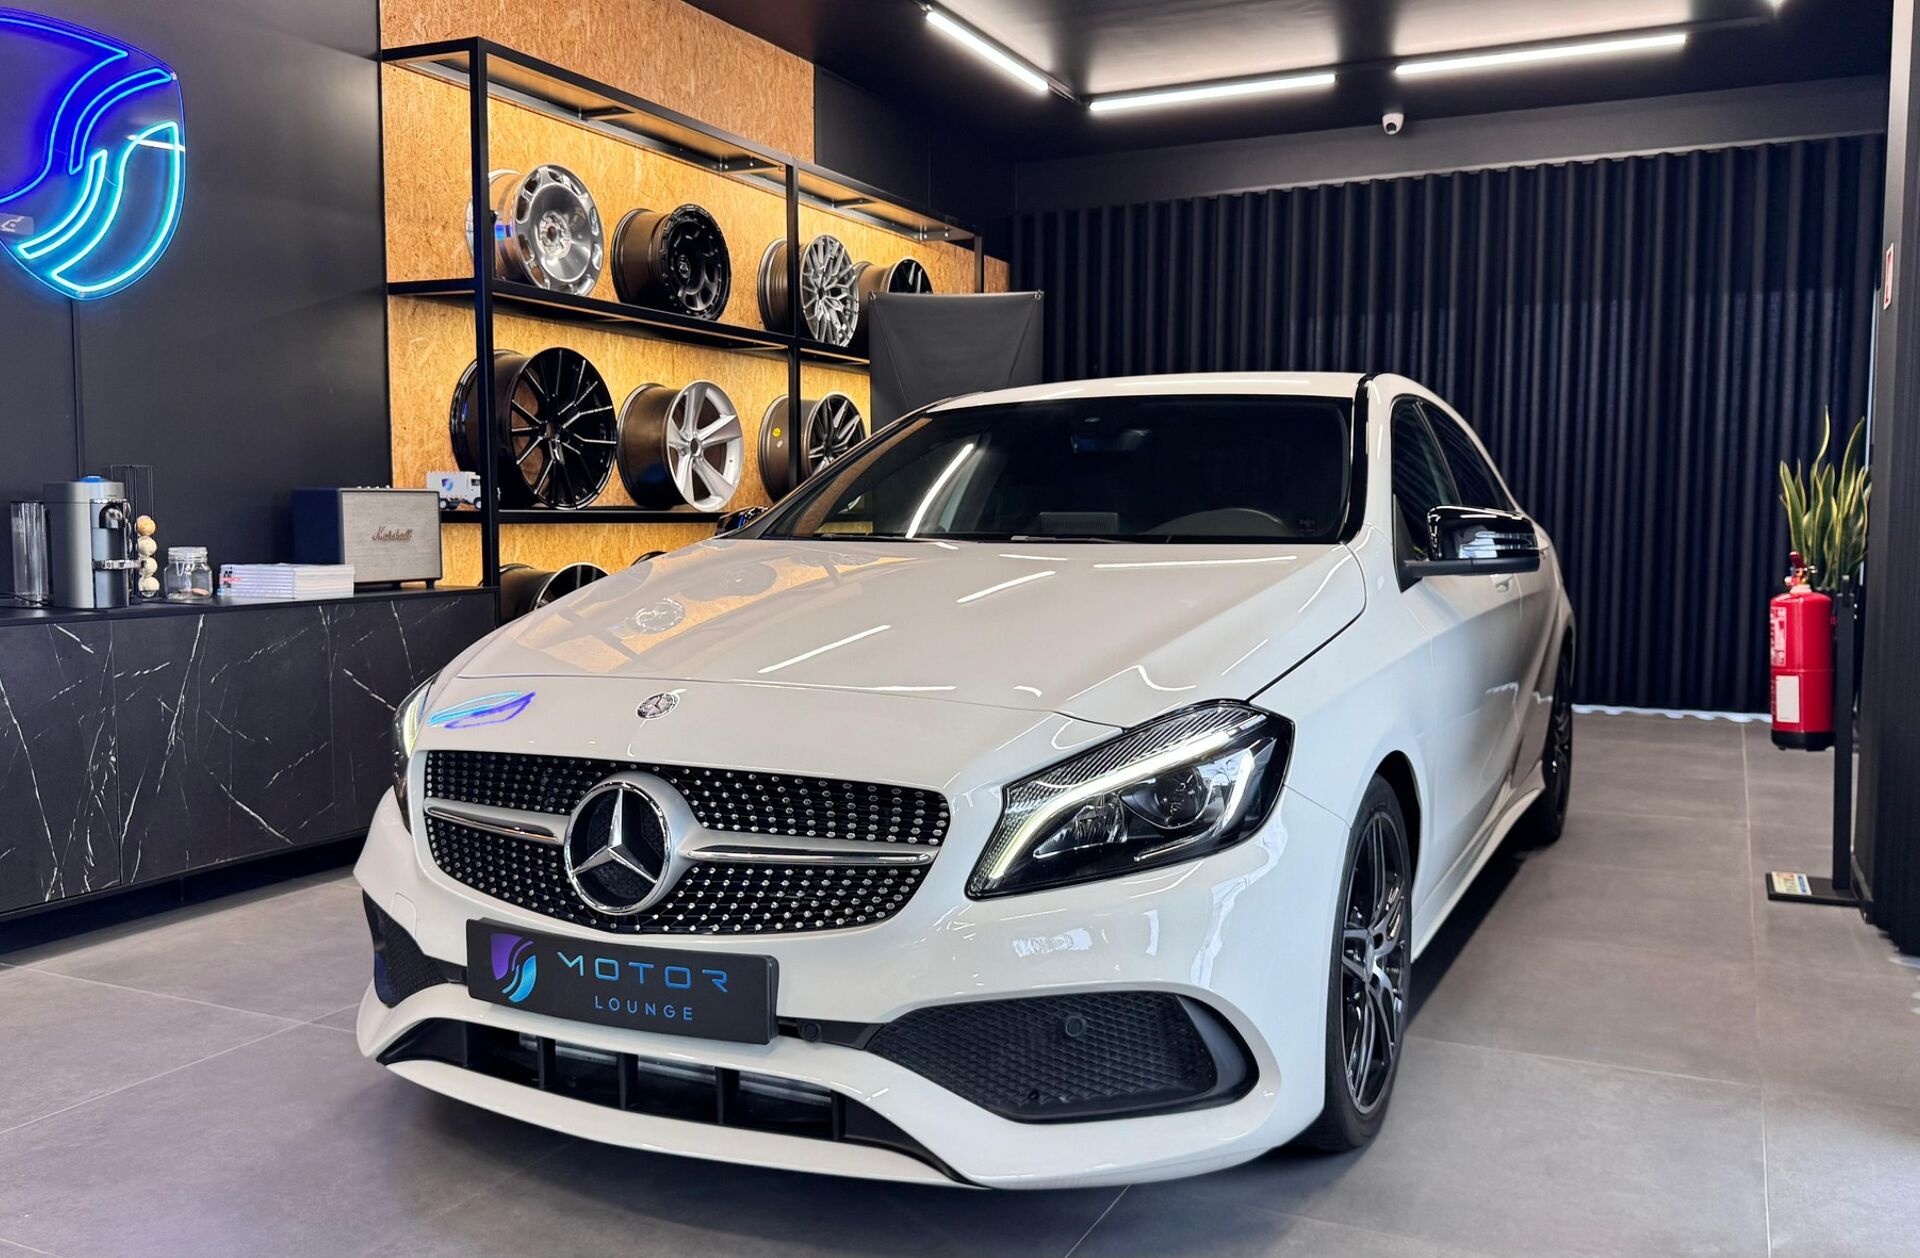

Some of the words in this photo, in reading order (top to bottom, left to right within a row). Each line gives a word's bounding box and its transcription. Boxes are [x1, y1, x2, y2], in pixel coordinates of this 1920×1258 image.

[372, 526, 413, 541] Marshall
[557, 951, 729, 993] MOTOR
[594, 995, 693, 1021] LOUNGE
